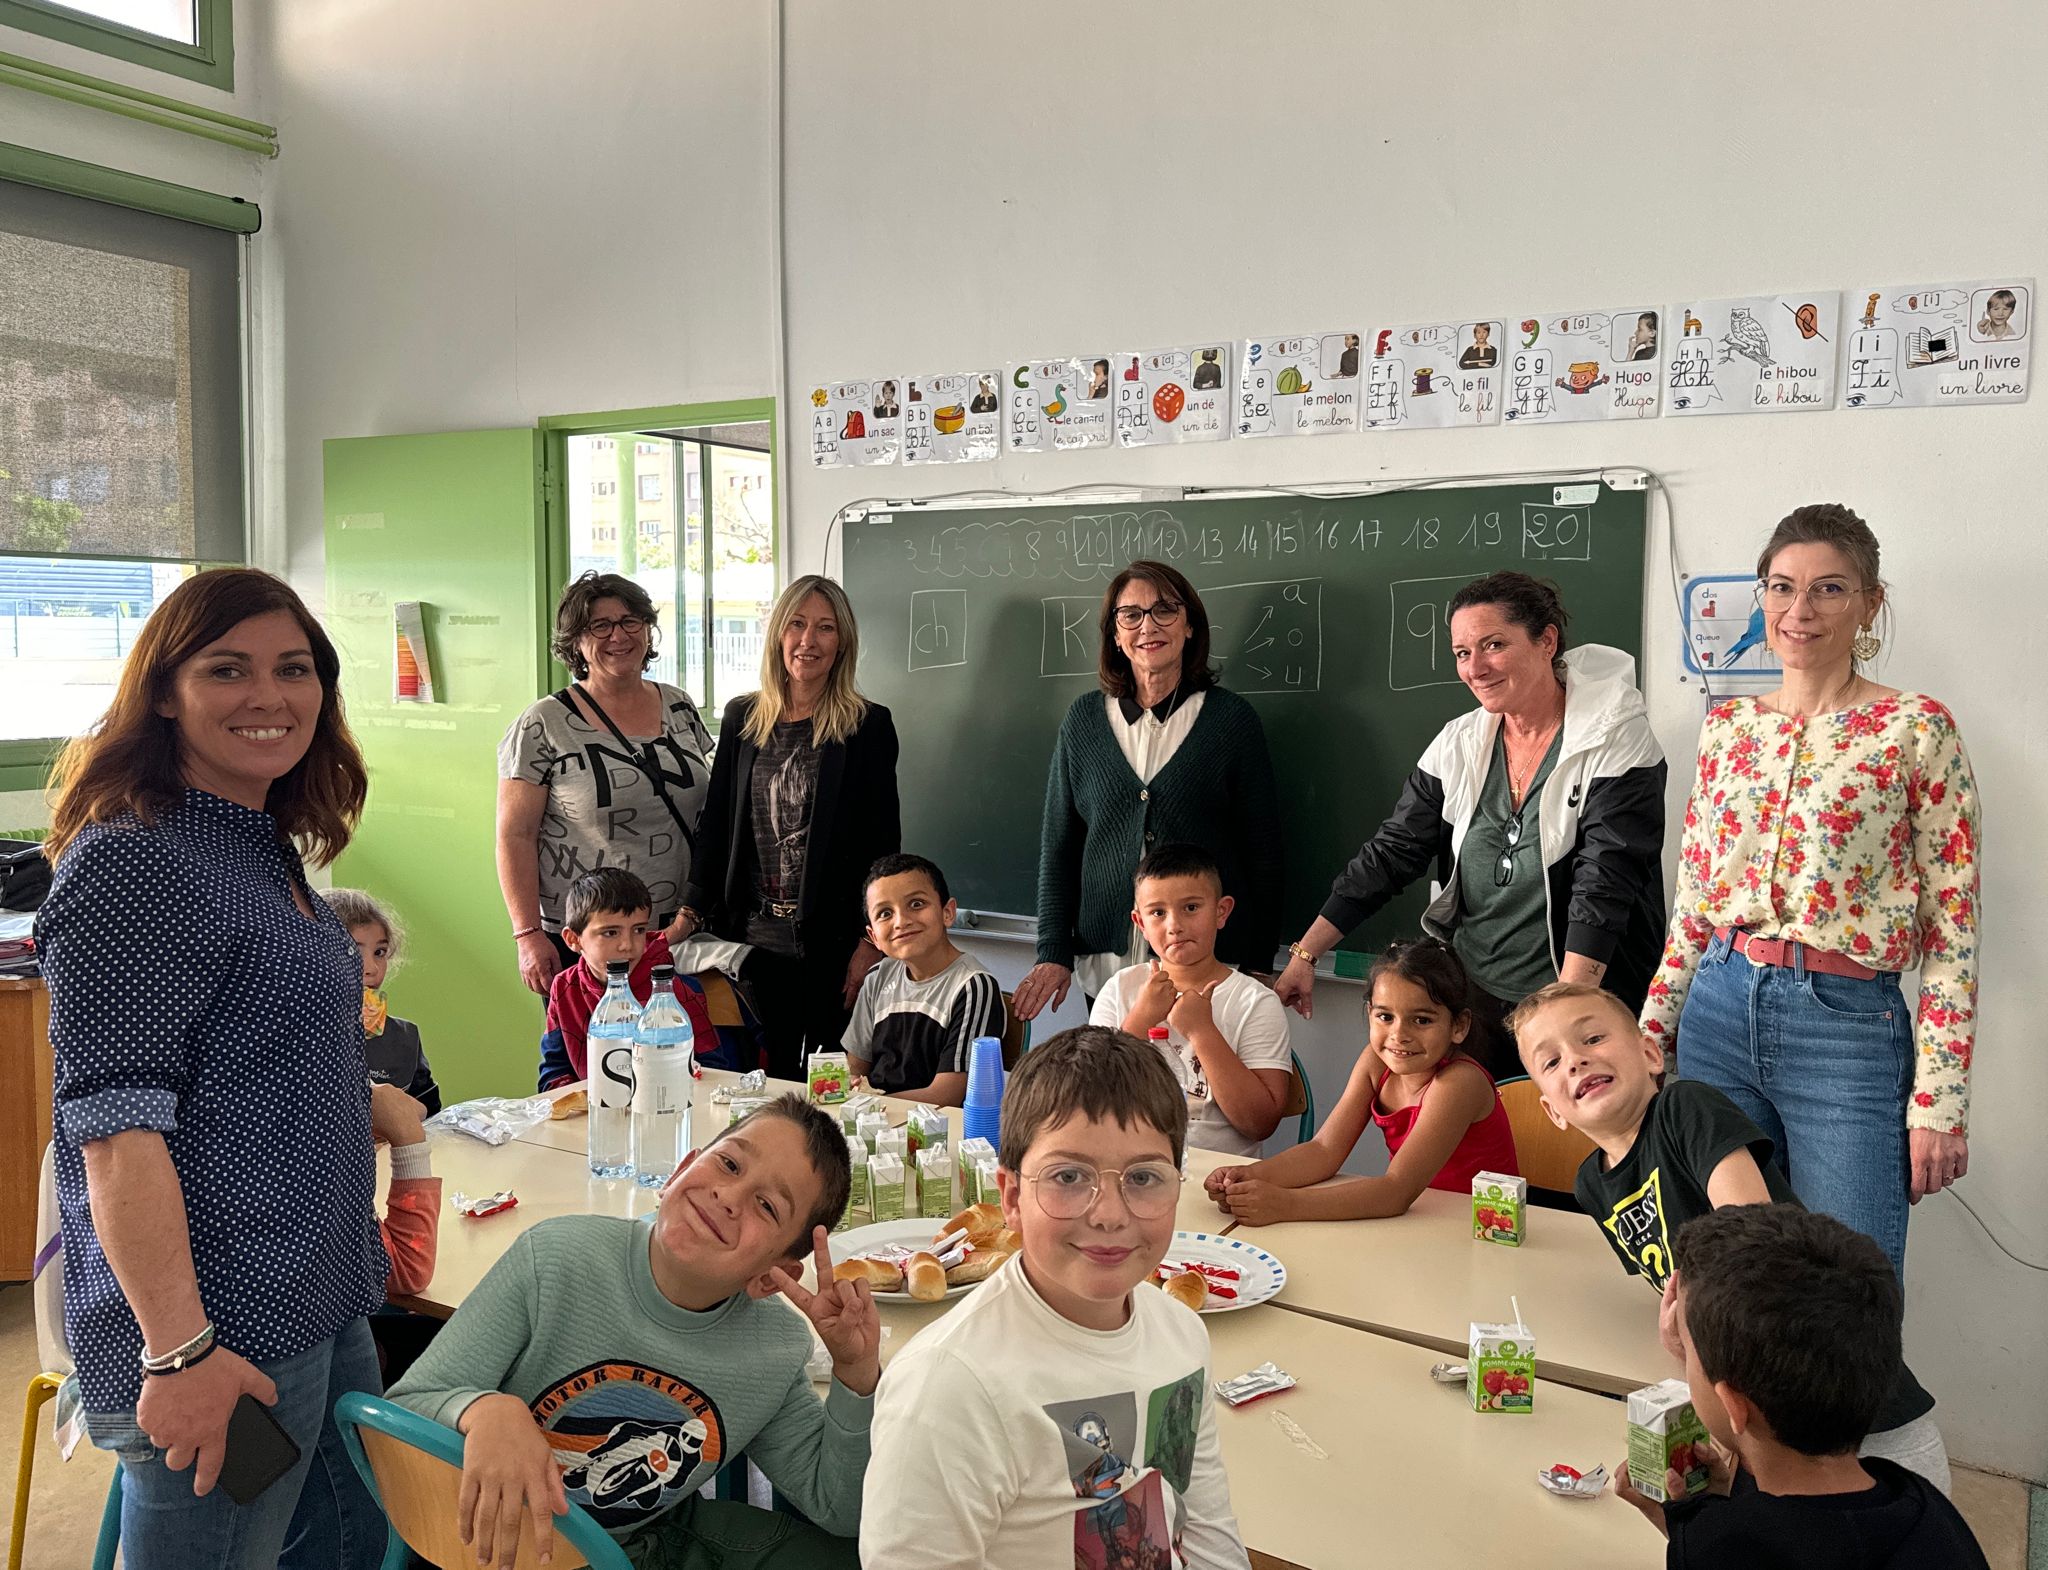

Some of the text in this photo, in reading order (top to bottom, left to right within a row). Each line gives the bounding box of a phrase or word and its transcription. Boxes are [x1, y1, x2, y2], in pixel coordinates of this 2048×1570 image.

[1959, 355, 2021, 371] un livre
[1616, 370, 1652, 386] Hugo
[1759, 366, 1817, 380] le hibou
[1463, 377, 1489, 391] le fil
[1939, 371, 2024, 396] un livre
[1303, 391, 1353, 406] le melon
[1614, 387, 1656, 418] Hugo
[1754, 383, 1822, 405] le hibou
[1187, 397, 1215, 412] un dé
[1458, 393, 1494, 424] le fil
[1063, 413, 1105, 425] le canard
[1182, 413, 1219, 433] un dé
[1297, 408, 1354, 428] le melon
[868, 426, 896, 438] un sac
[965, 426, 977, 436] un
[903, 539, 917, 561] 3
[930, 535, 942, 565] 4
[1026, 531, 1041, 561] 8
[1074, 527, 1108, 558] 10
[1121, 527, 1144, 556] 11
[1153, 527, 1184, 560] 12
[1193, 527, 1224, 558] 13
[1234, 524, 1259, 558] 14
[1273, 522, 1298, 554] 15
[1314, 519, 1339, 549] 16
[1350, 518, 1384, 551] 17
[1401, 517, 1442, 550] 18
[1458, 511, 1502, 551] 19
[1525, 512, 1579, 549] 20
[1283, 584, 1308, 605] a
[1701, 588, 1718, 599] dos
[915, 600, 948, 654] ch
[1695, 634, 1721, 645] queue
[608, 807, 641, 841] R
[532, 1368, 710, 1428] MOTOR RACER
